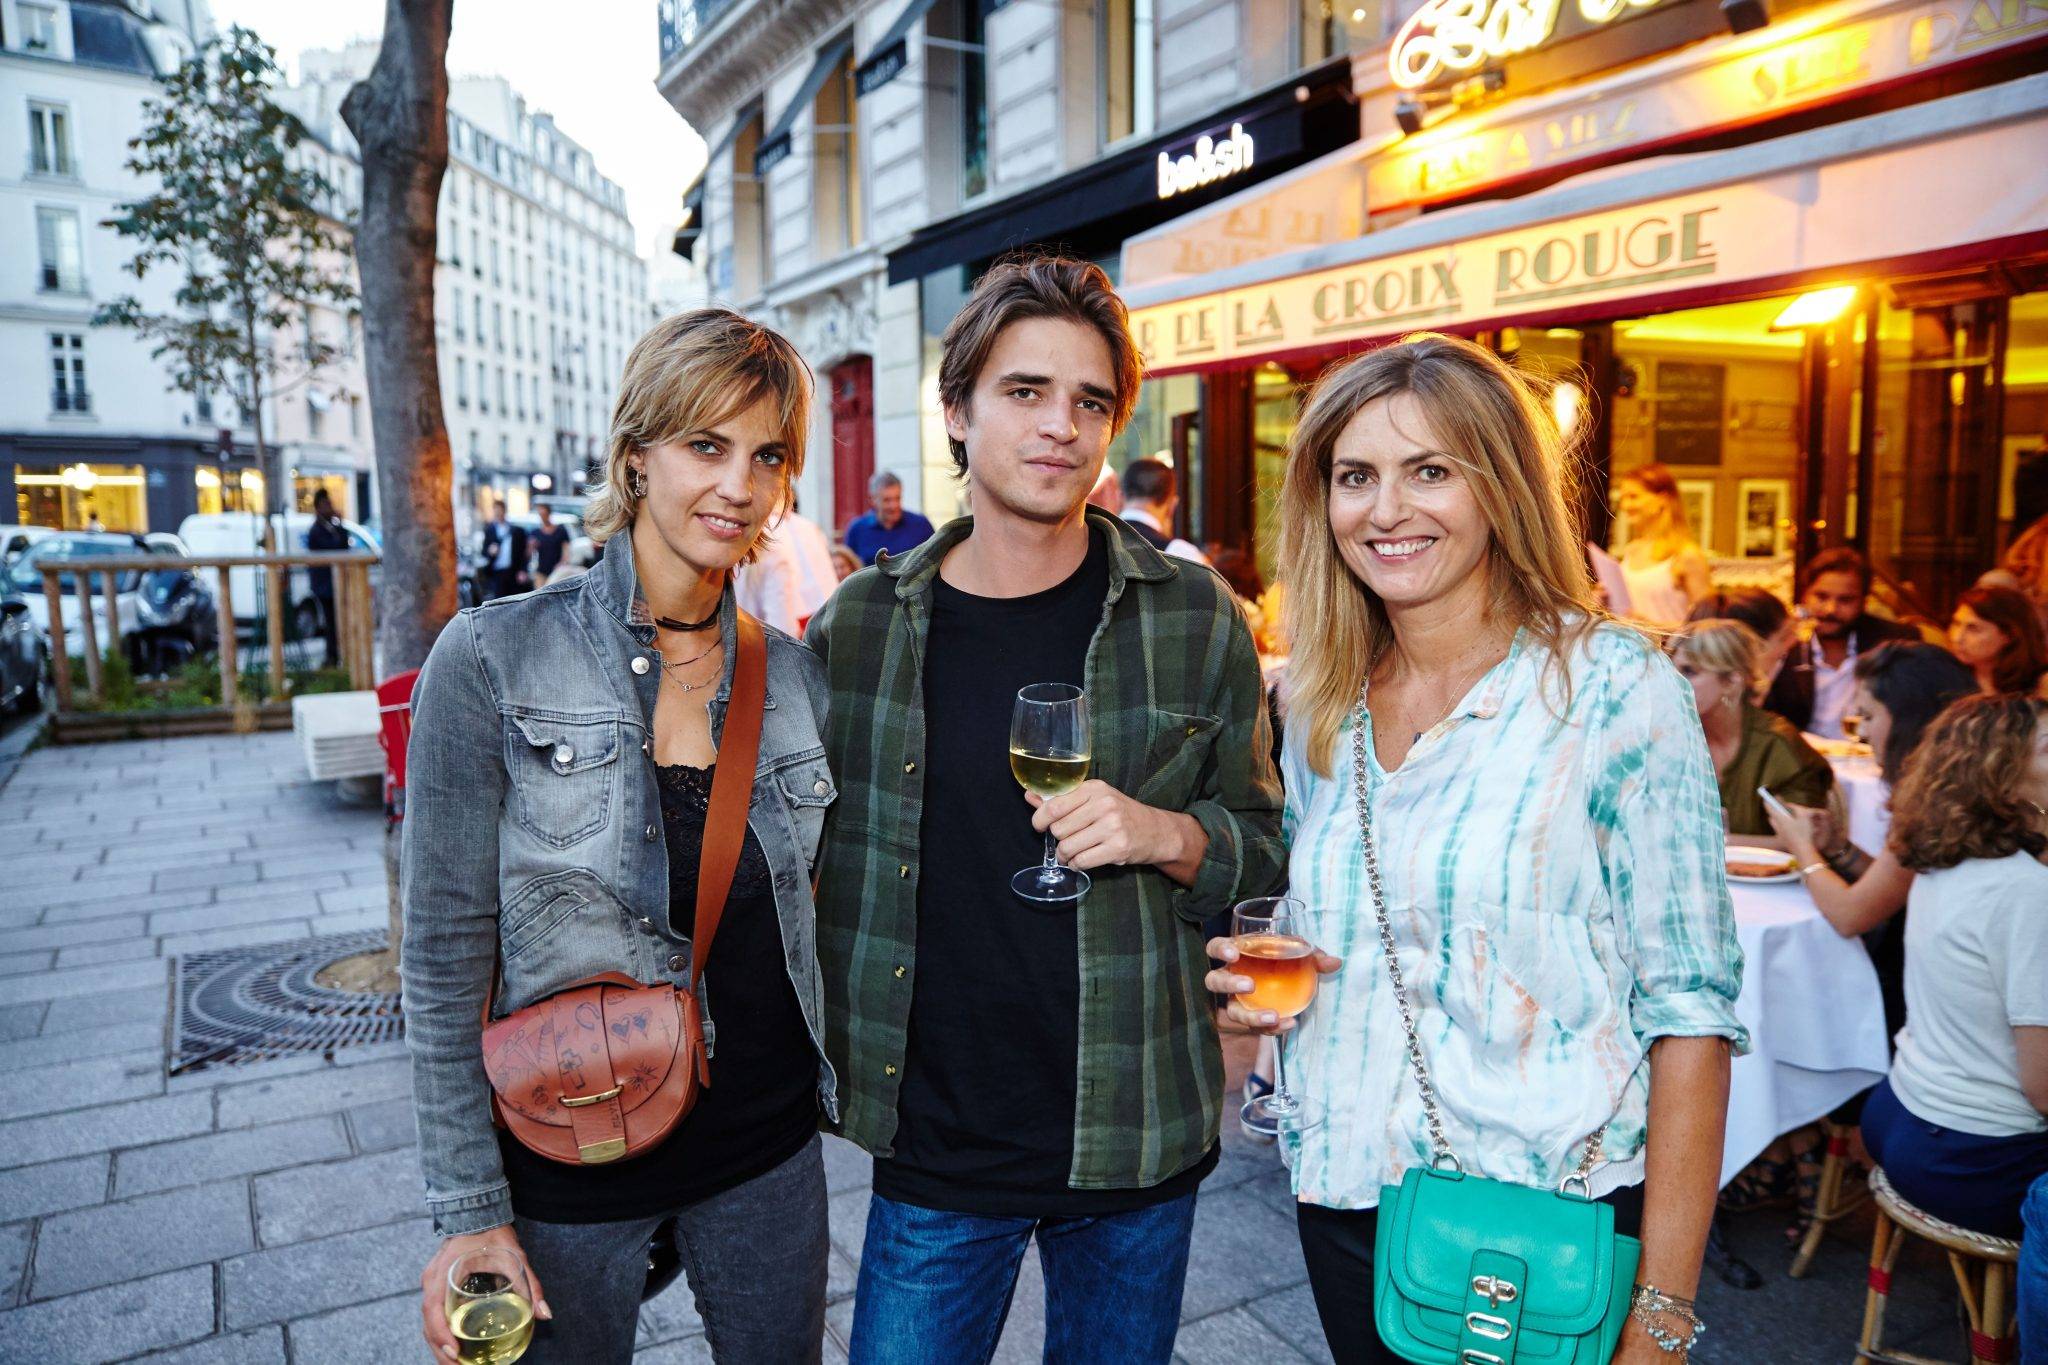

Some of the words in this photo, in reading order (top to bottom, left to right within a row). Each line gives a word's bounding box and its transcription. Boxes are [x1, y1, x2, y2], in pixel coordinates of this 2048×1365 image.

[1176, 306, 1215, 346] DE
[1235, 296, 1283, 338] LA
[1313, 258, 1460, 323] CROIX
[1496, 207, 1719, 292] ROUGE
